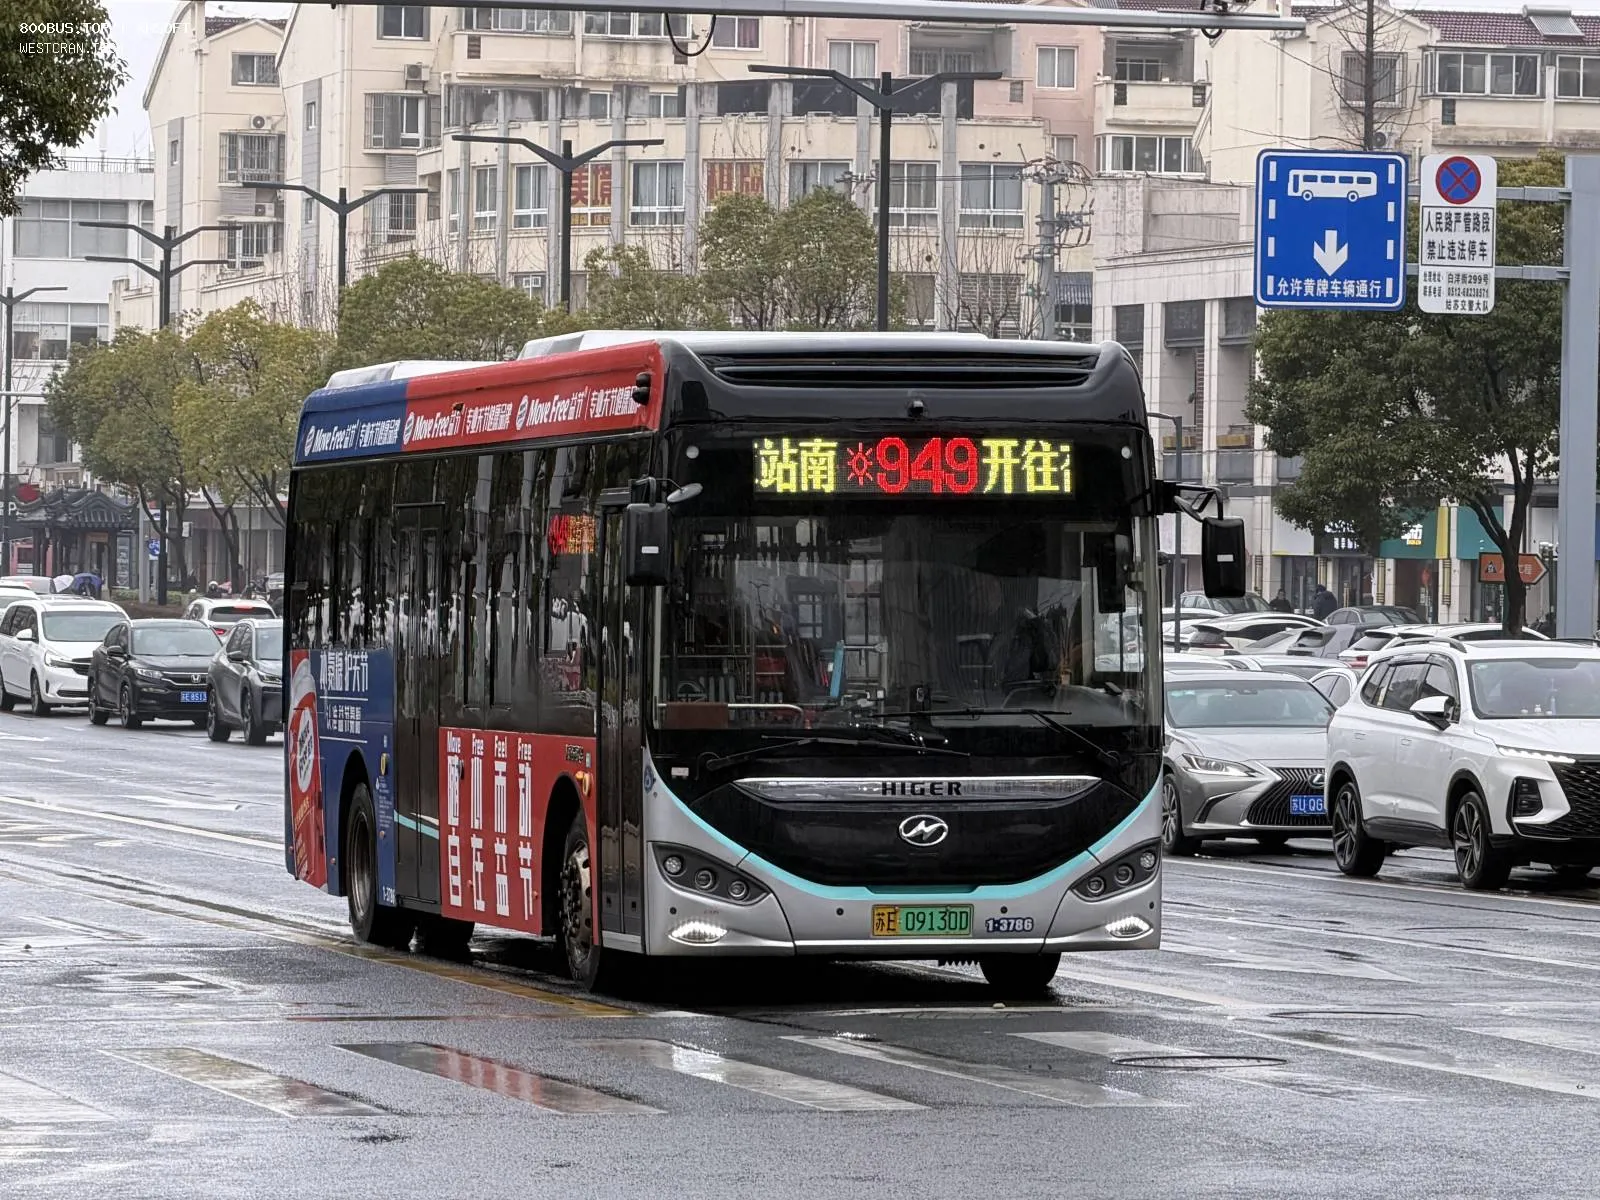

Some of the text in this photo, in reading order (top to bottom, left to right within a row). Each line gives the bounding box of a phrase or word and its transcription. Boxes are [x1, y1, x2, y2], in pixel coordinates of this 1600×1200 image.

[1425, 210, 1490, 234] 人民路严管路段
[1427, 239, 1488, 261] 禁止违法停车
[1277, 277, 1381, 299] 允许黄牌车辆通行
[525, 398, 549, 427] Move
[411, 415, 434, 442] Move
[876, 437, 979, 493] 949
[982, 438, 1070, 493] 开往
[471, 733, 484, 756] Free
[494, 736, 508, 759] Feel
[518, 738, 532, 761] Free
[881, 781, 962, 796] HIGER
